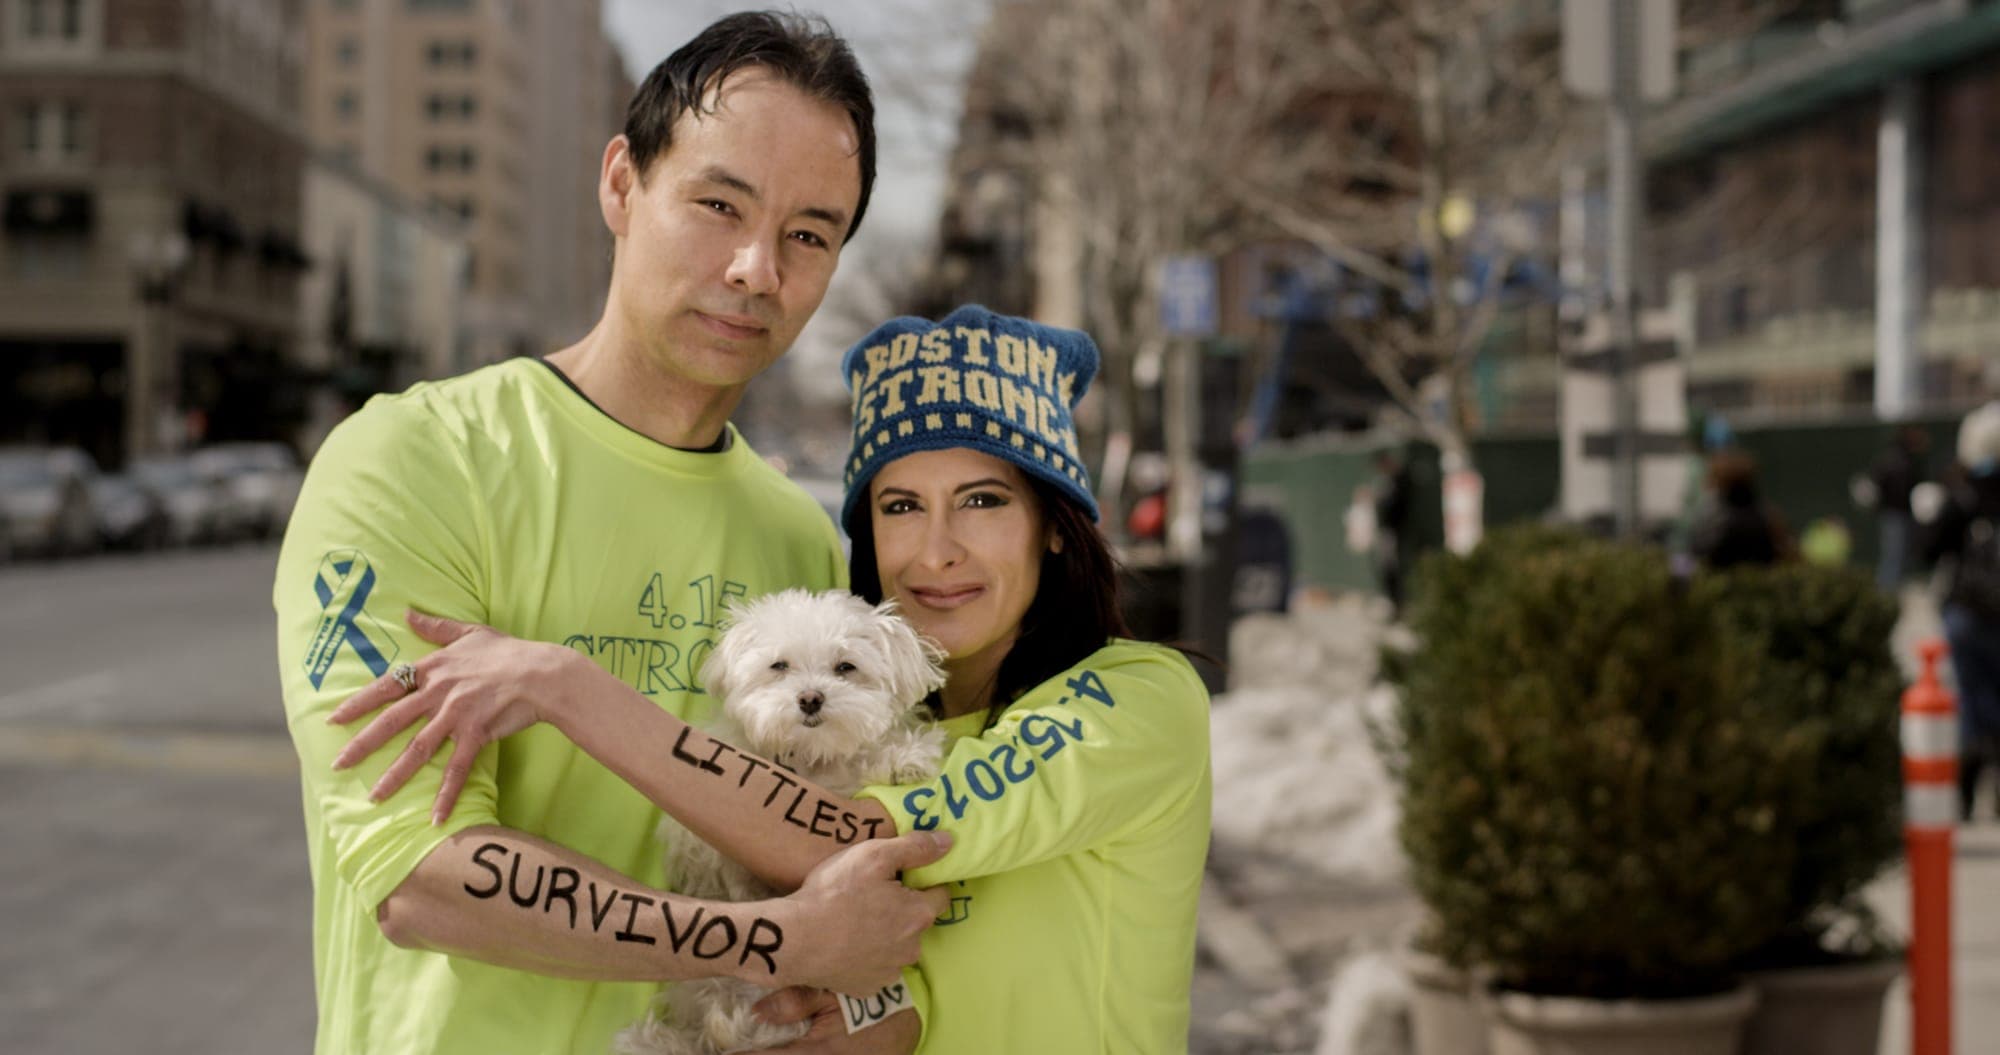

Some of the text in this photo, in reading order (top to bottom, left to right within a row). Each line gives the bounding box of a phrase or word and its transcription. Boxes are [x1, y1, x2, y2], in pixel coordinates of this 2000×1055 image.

[864, 325, 1057, 396] BOSTON
[671, 726, 884, 844] LITTLEST
[464, 843, 783, 975] SURVIVOR
